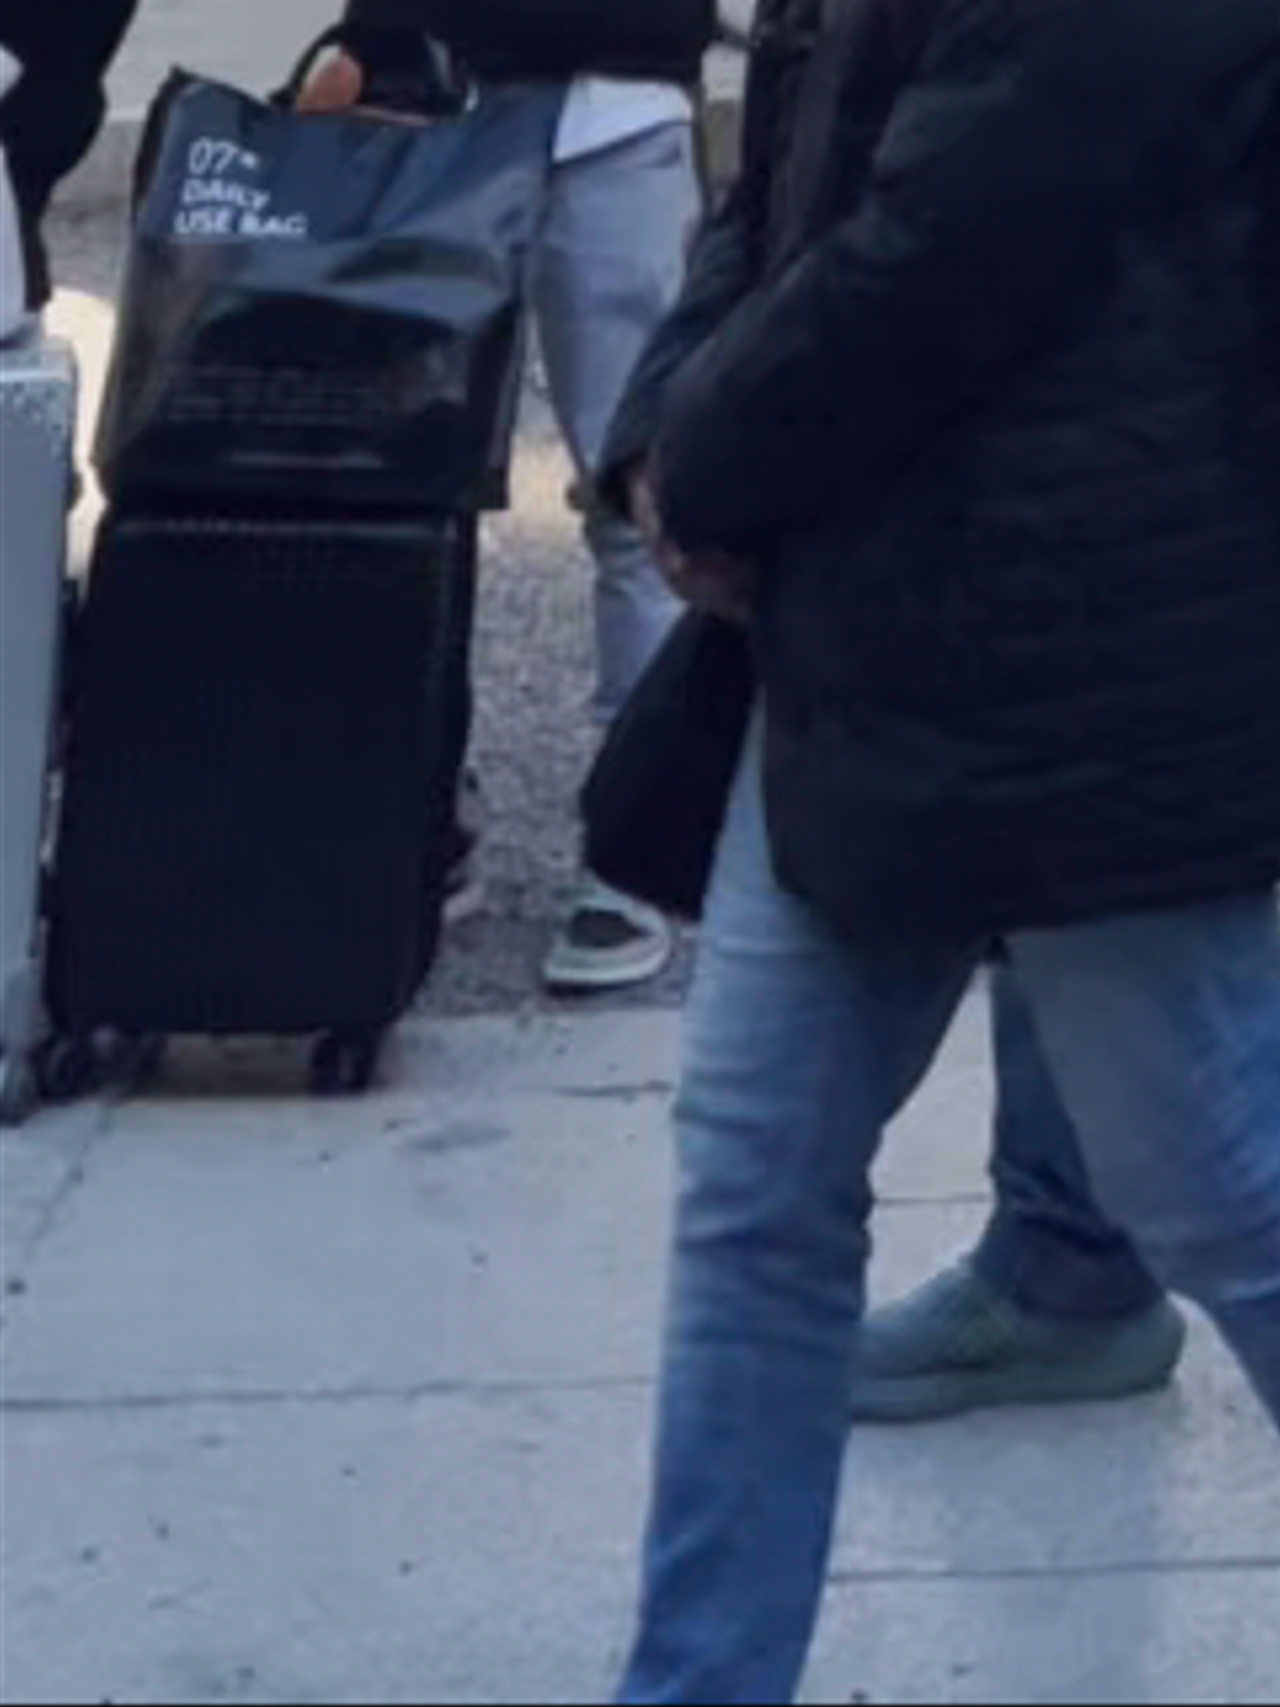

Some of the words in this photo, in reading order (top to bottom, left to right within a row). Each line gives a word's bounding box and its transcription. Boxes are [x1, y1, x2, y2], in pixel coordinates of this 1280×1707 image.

[182, 178, 271, 211] DAILY
[173, 208, 232, 234] USE
[238, 210, 307, 237] BAG
